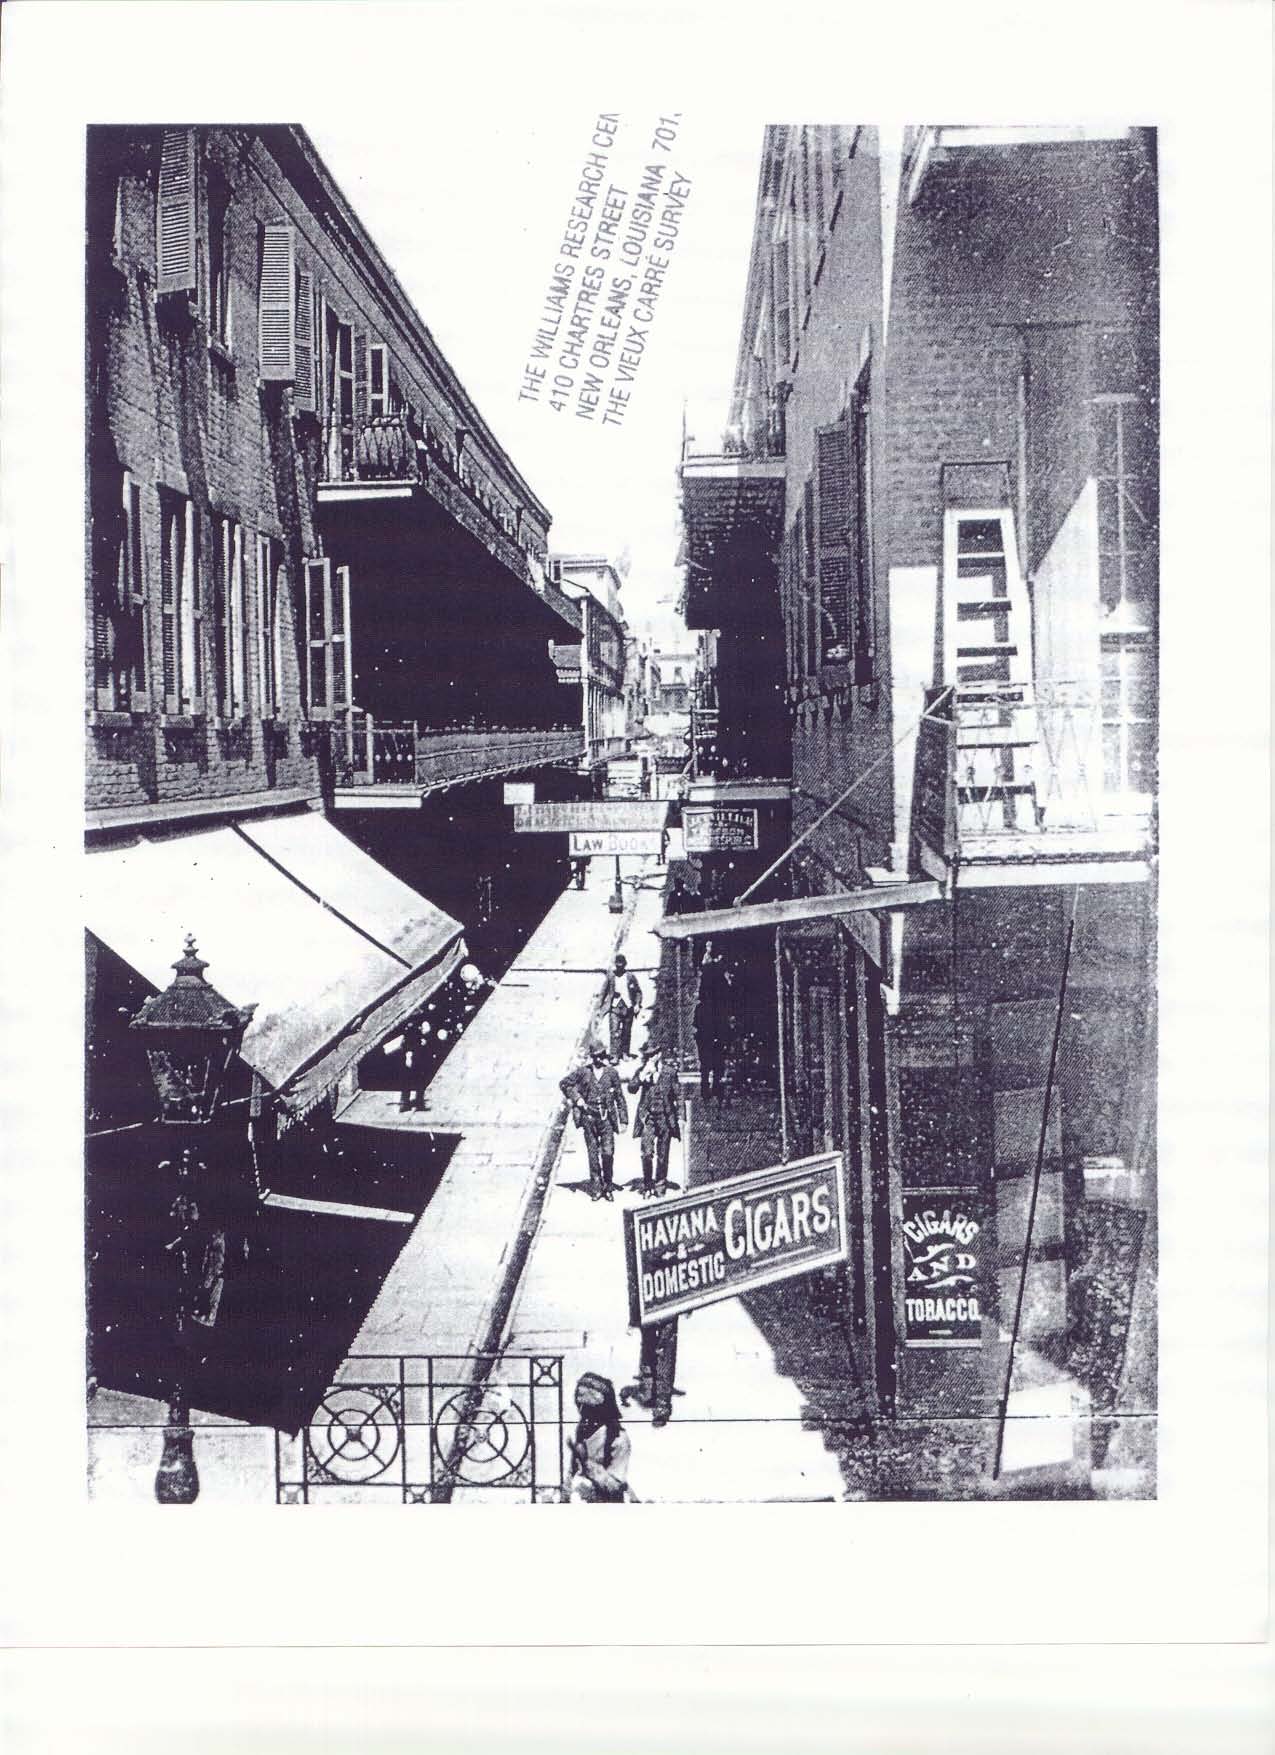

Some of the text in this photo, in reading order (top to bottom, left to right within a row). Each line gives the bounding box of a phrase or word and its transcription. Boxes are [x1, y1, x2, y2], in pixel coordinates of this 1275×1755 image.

[574, 834, 604, 852] LAW
[640, 1205, 719, 1251] HAVANA
[903, 1209, 979, 1245] CIGARS
[642, 1251, 725, 1302] DOMESTIC
[907, 1253, 977, 1281] AND
